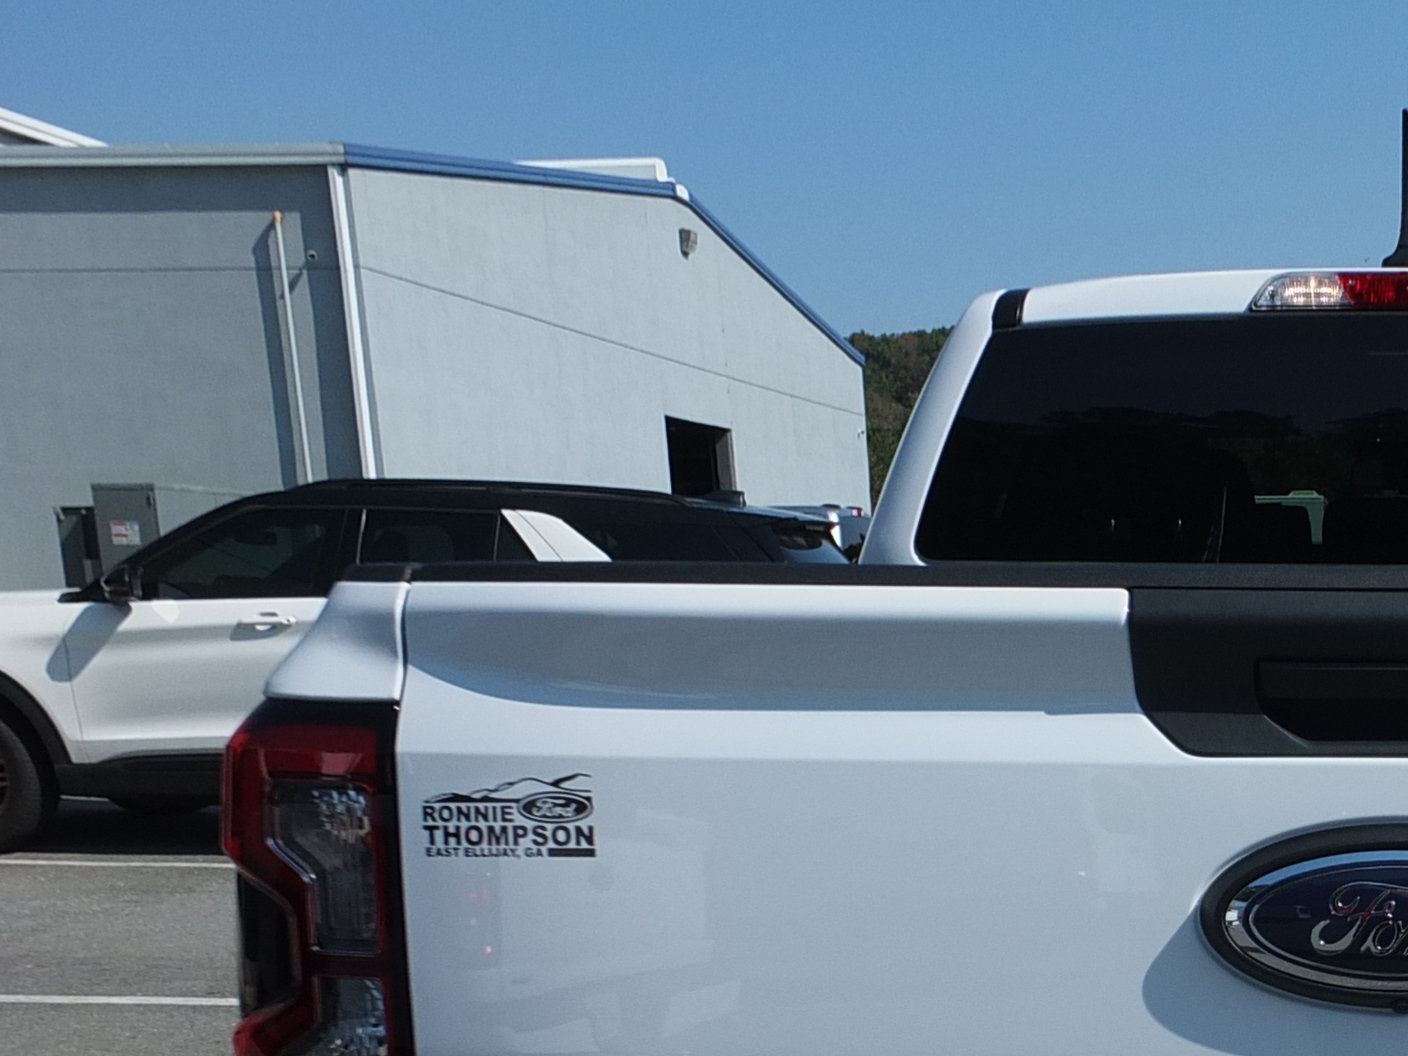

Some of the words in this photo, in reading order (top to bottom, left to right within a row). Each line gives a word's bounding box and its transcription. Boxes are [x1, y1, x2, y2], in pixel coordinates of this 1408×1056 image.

[422, 805, 515, 823] RONNIE
[531, 797, 578, 818] Ford
[422, 825, 595, 847] THOMPSON
[426, 848, 459, 858] EAST
[524, 848, 544, 858] GA
